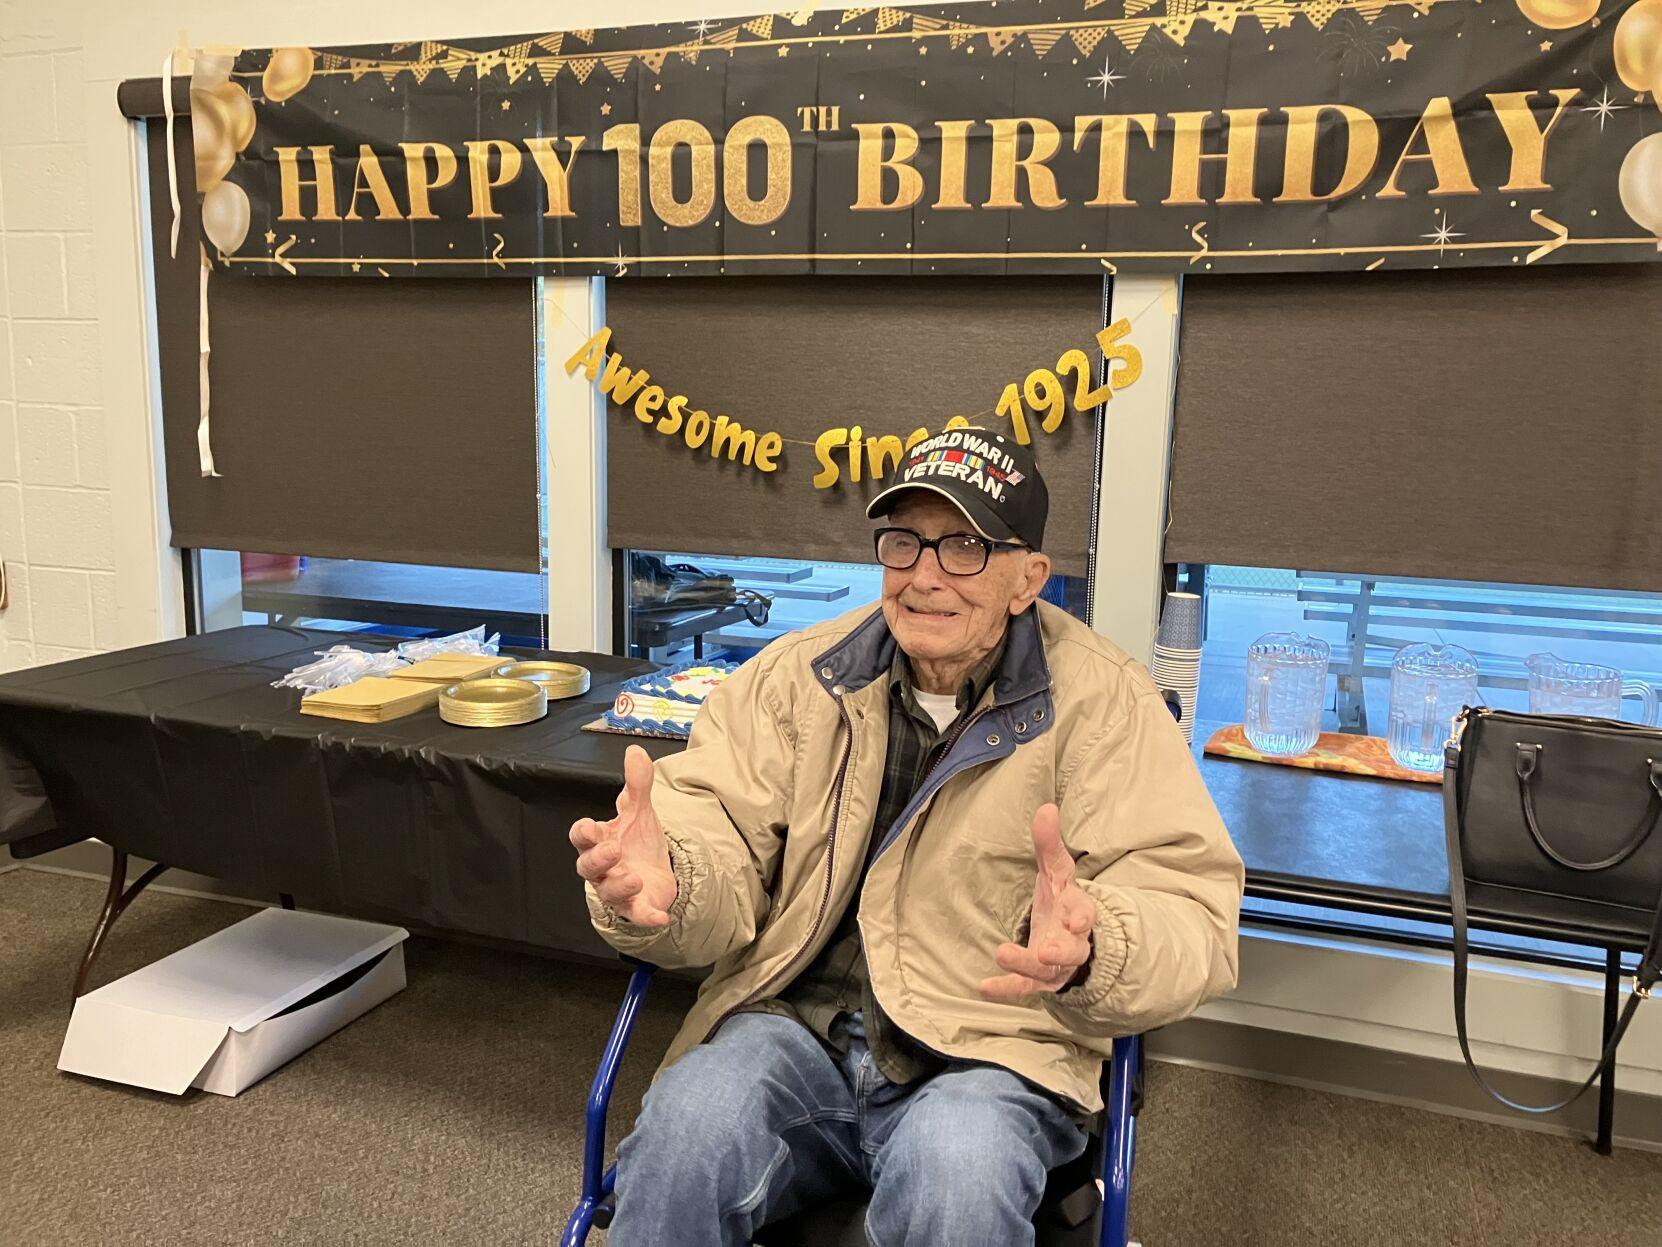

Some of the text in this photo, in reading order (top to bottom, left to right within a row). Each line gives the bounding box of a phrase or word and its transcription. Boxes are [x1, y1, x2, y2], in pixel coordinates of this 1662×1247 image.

[272, 135, 587, 221] HAPPY
[849, 87, 1581, 212] BIRTHDAY
[564, 317, 1144, 490] Awesome Sin 1925
[904, 460, 1003, 501] VETERAN
[911, 431, 1015, 474] WORLD WAR II
